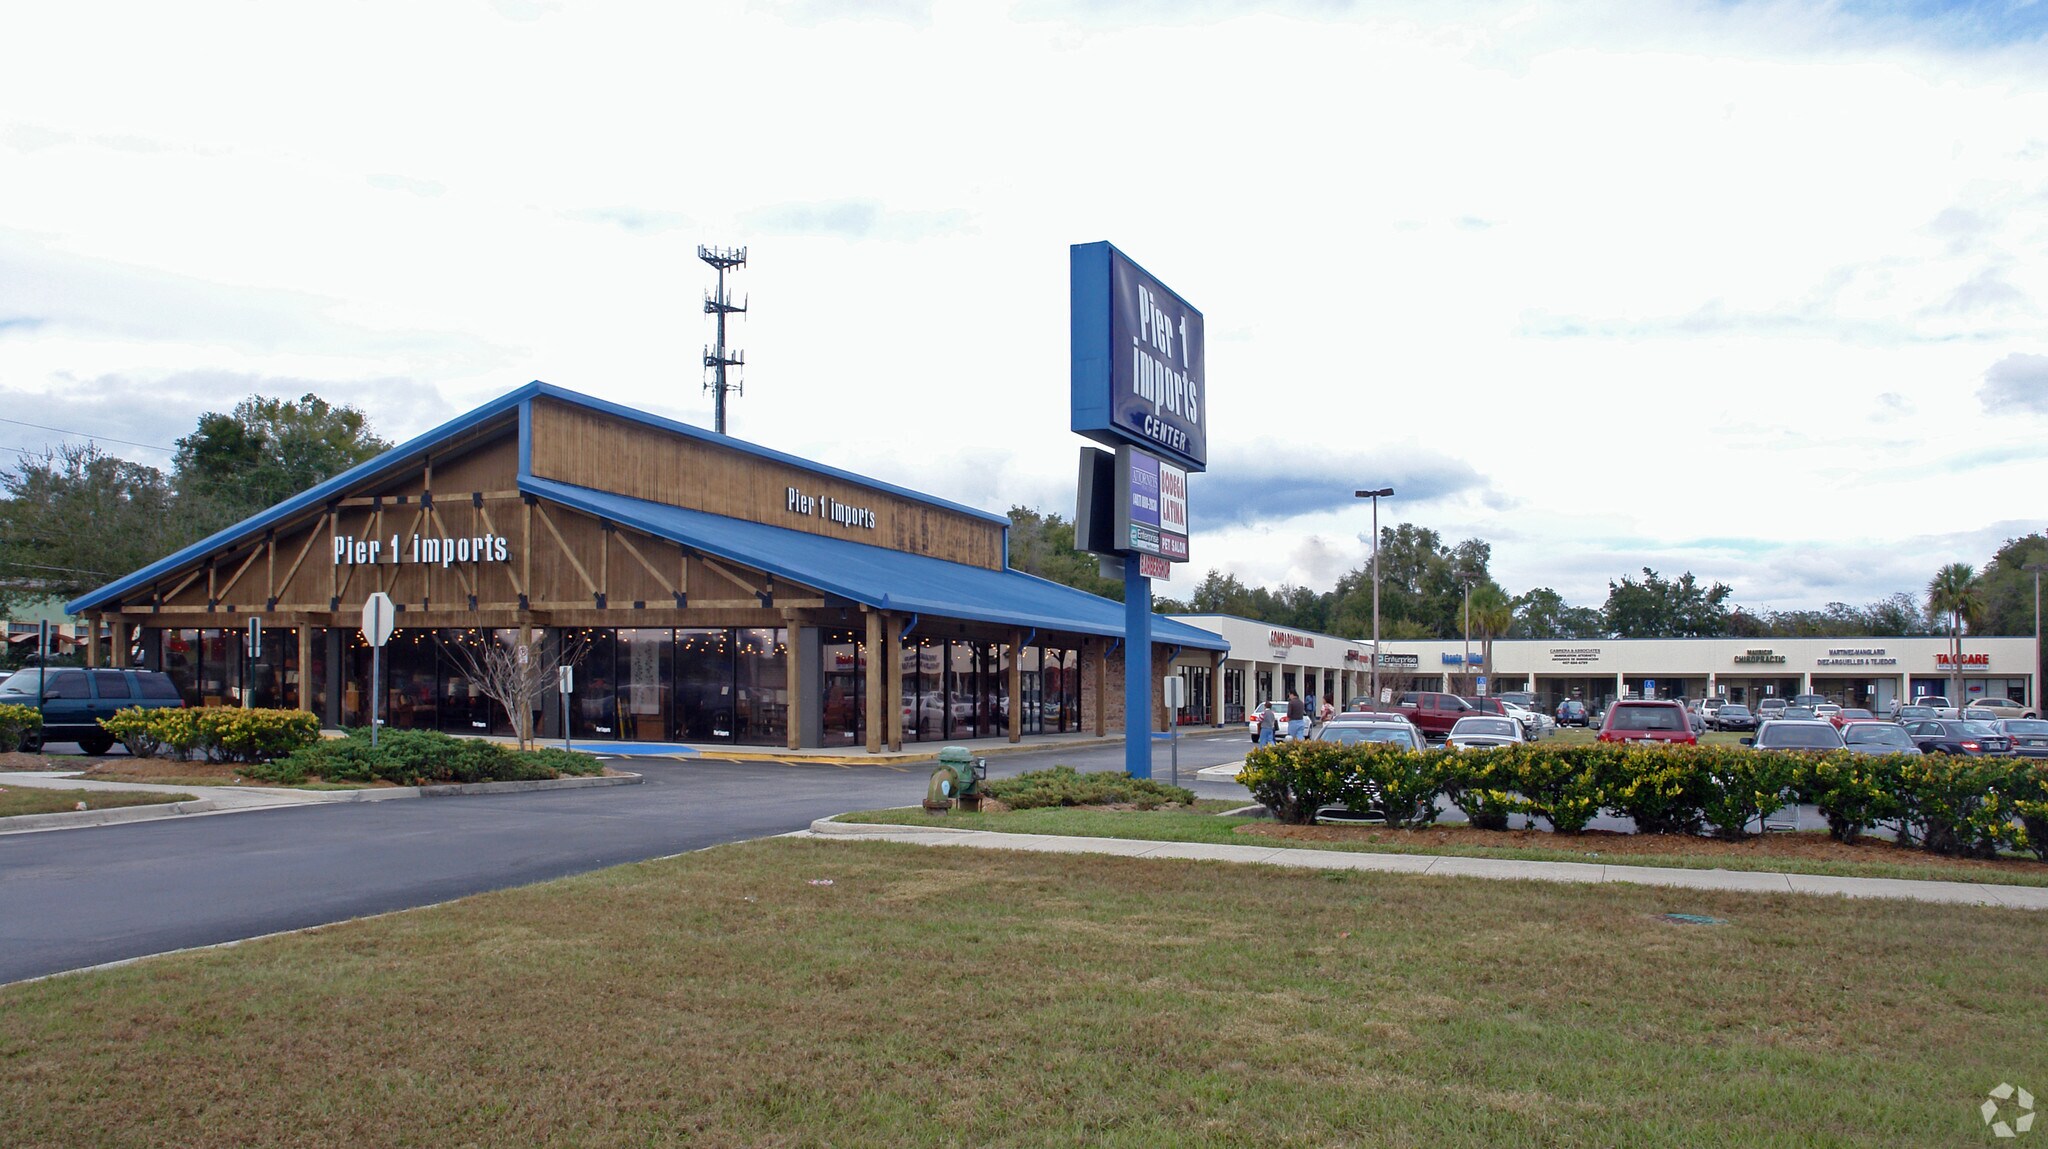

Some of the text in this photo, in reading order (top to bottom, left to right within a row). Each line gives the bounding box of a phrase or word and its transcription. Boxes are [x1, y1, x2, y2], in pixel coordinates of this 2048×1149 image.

[1138, 284, 1189, 369] Pier 1
[1133, 336, 1197, 425] imports
[1144, 414, 1186, 451] CENTER
[1162, 469, 1185, 501] BODEGA
[788, 487, 875, 529] Pier 1 imports
[1162, 497, 1185, 526] LATINA
[334, 533, 507, 569] Pier 1 imports
[1137, 528, 1159, 544] Enterprise
[1162, 537, 1171, 550] PET
[1384, 655, 1417, 663] Enterprise
[1734, 655, 1786, 664] CHIROPRACTIC
[1960, 653, 1989, 665] CARE
